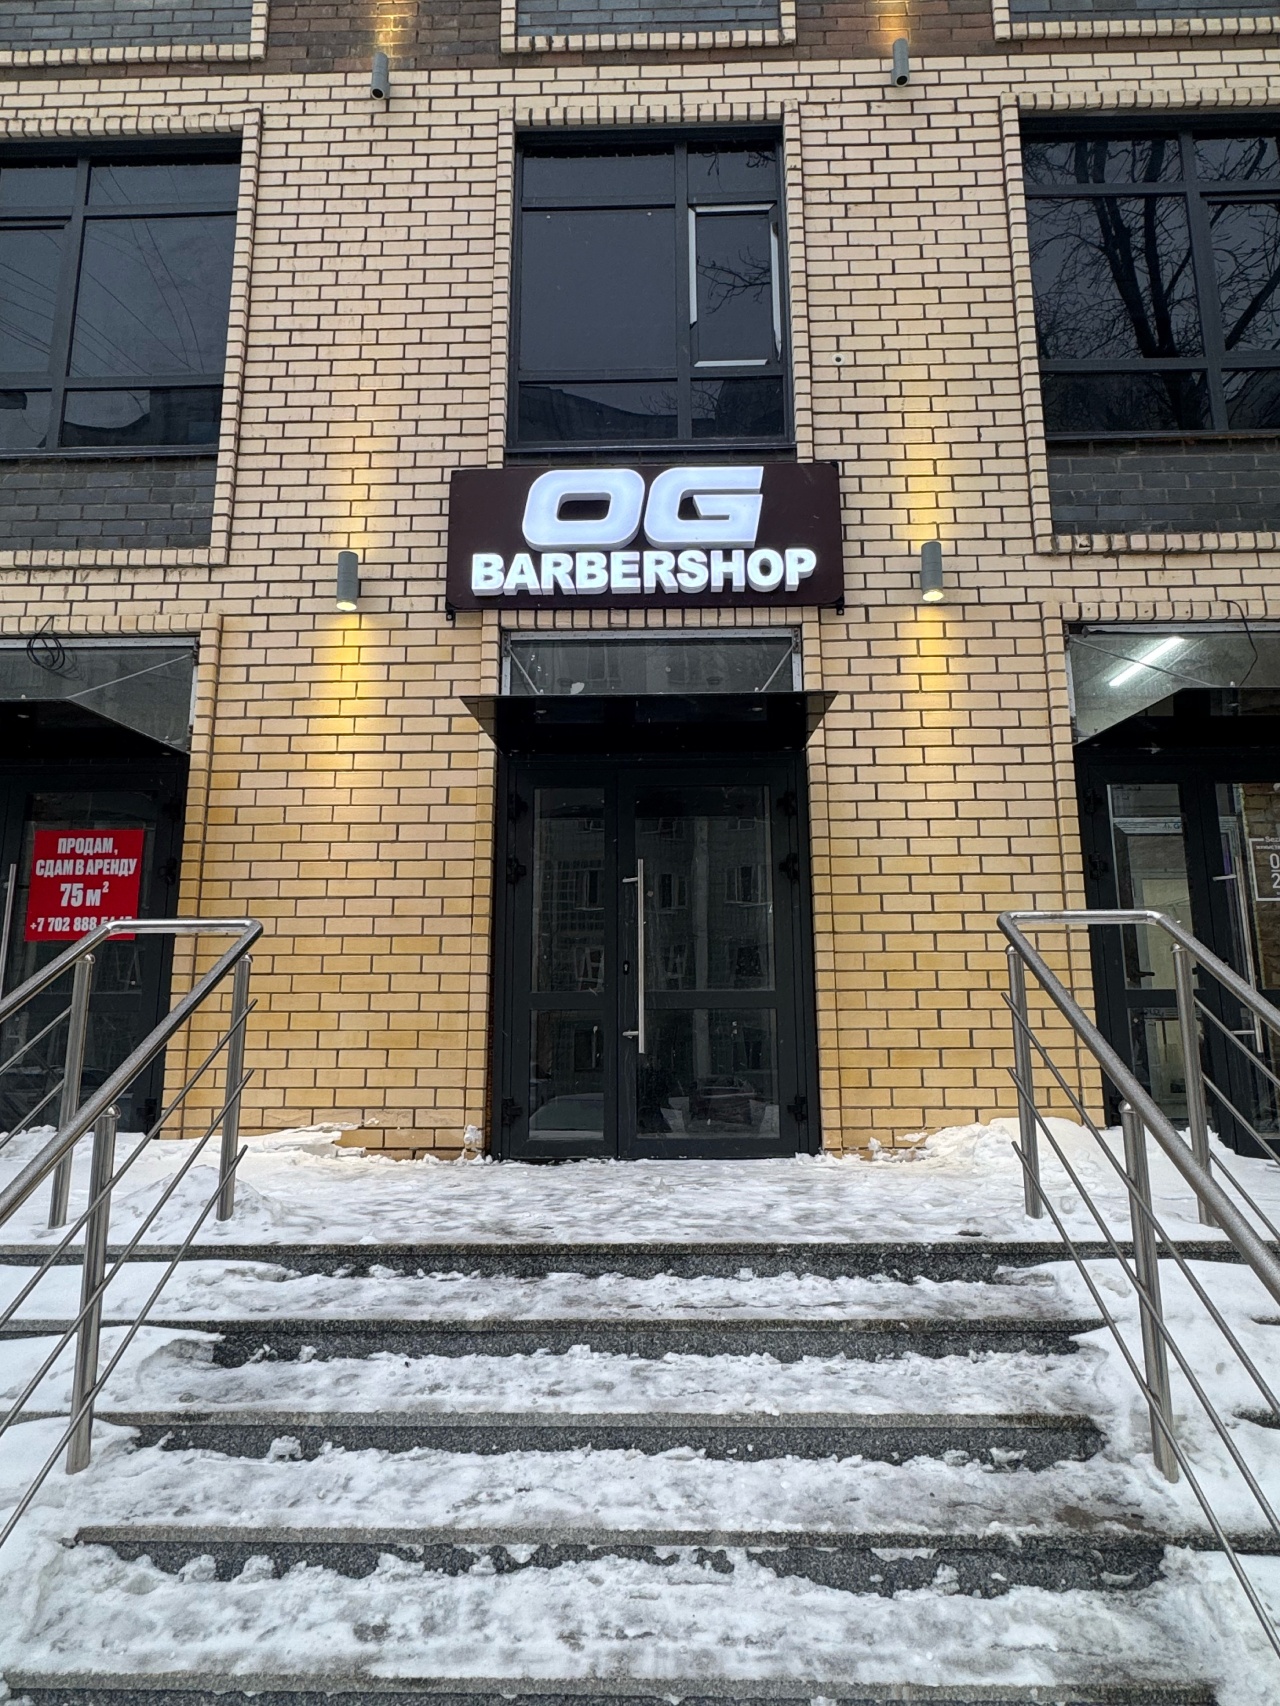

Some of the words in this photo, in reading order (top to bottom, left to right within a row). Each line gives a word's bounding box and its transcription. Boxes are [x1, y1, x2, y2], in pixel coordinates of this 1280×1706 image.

[522, 466, 764, 552] OG
[471, 549, 817, 596] BARBERSHOP
[57, 838, 118, 856] ПРОДАМ,
[35, 859, 73, 877] СДАМ
[74, 859, 83, 875] В
[85, 858, 137, 876] АРЕНДУ
[60, 883, 84, 907] 75
[30, 917, 45, 931] +7
[48, 917, 70, 931] 702
[73, 917, 98, 931] 888
